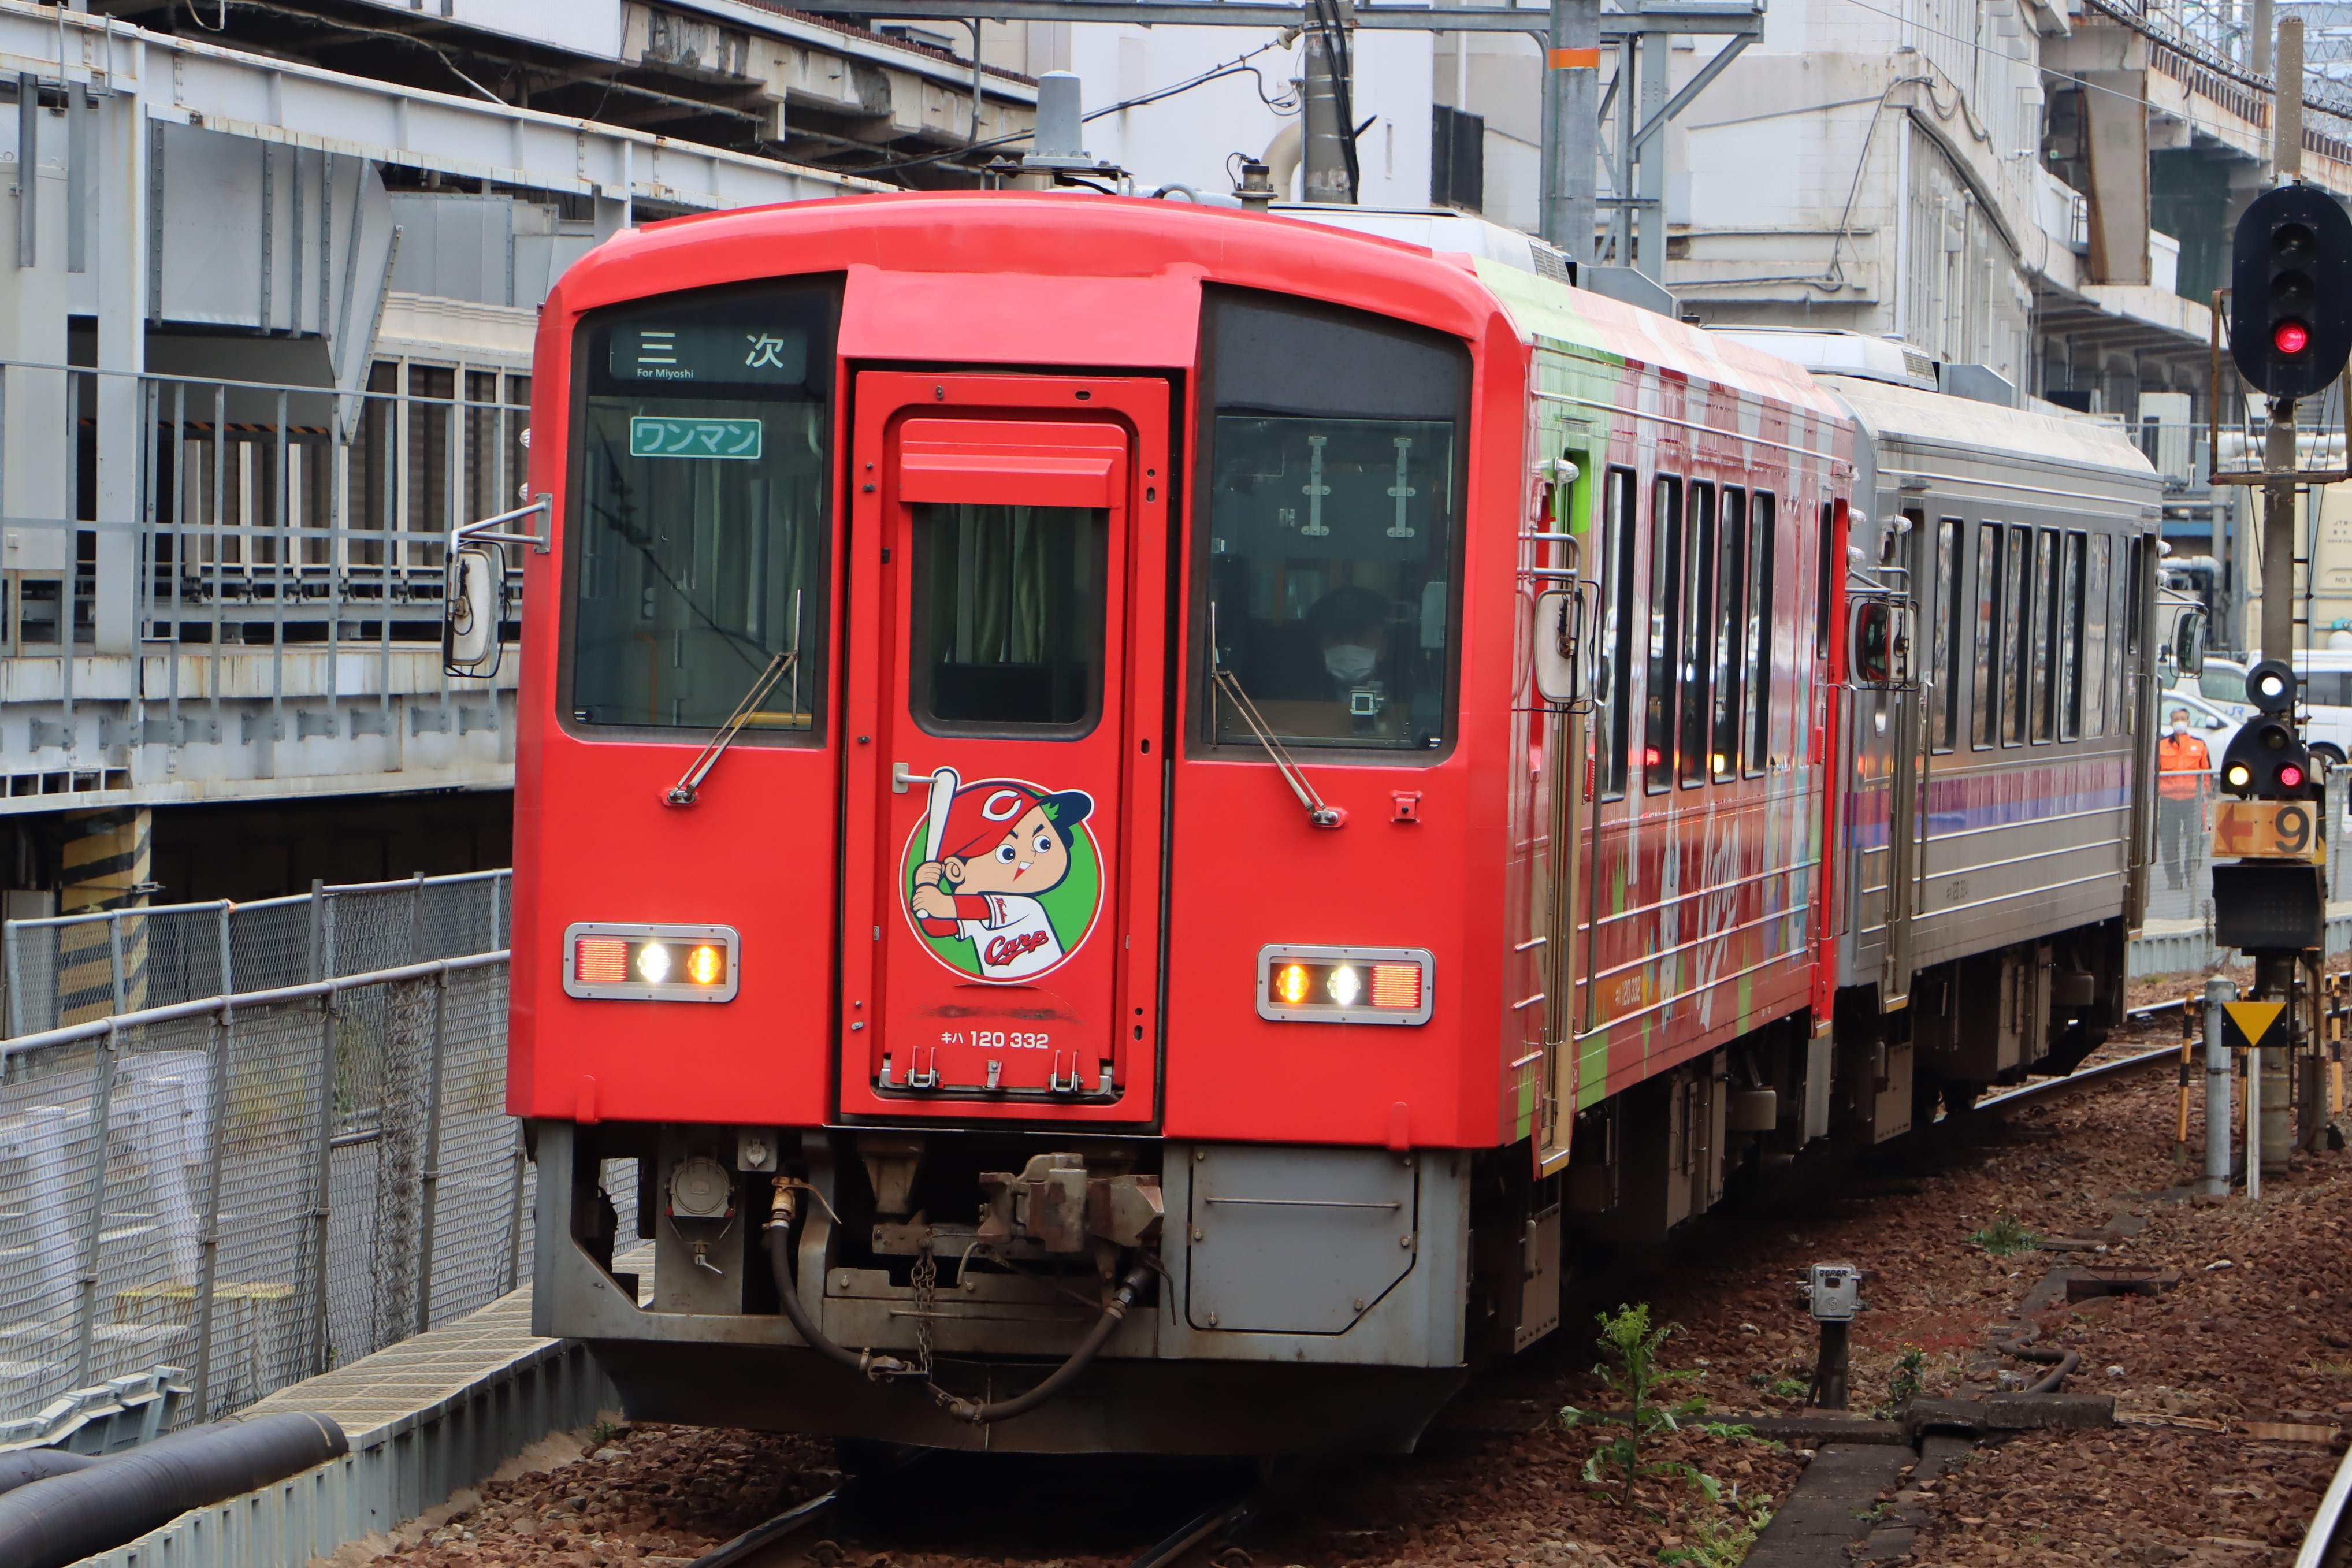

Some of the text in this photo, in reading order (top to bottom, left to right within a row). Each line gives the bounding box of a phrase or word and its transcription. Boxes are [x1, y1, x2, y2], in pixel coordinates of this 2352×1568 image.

[637, 369, 694, 380] For Miyoshi
[637, 423, 755, 453] ワンマン
[2275, 806, 2310, 853] 9
[984, 930, 1049, 967] Carp
[941, 1031, 1049, 1049] キハ 120 332
